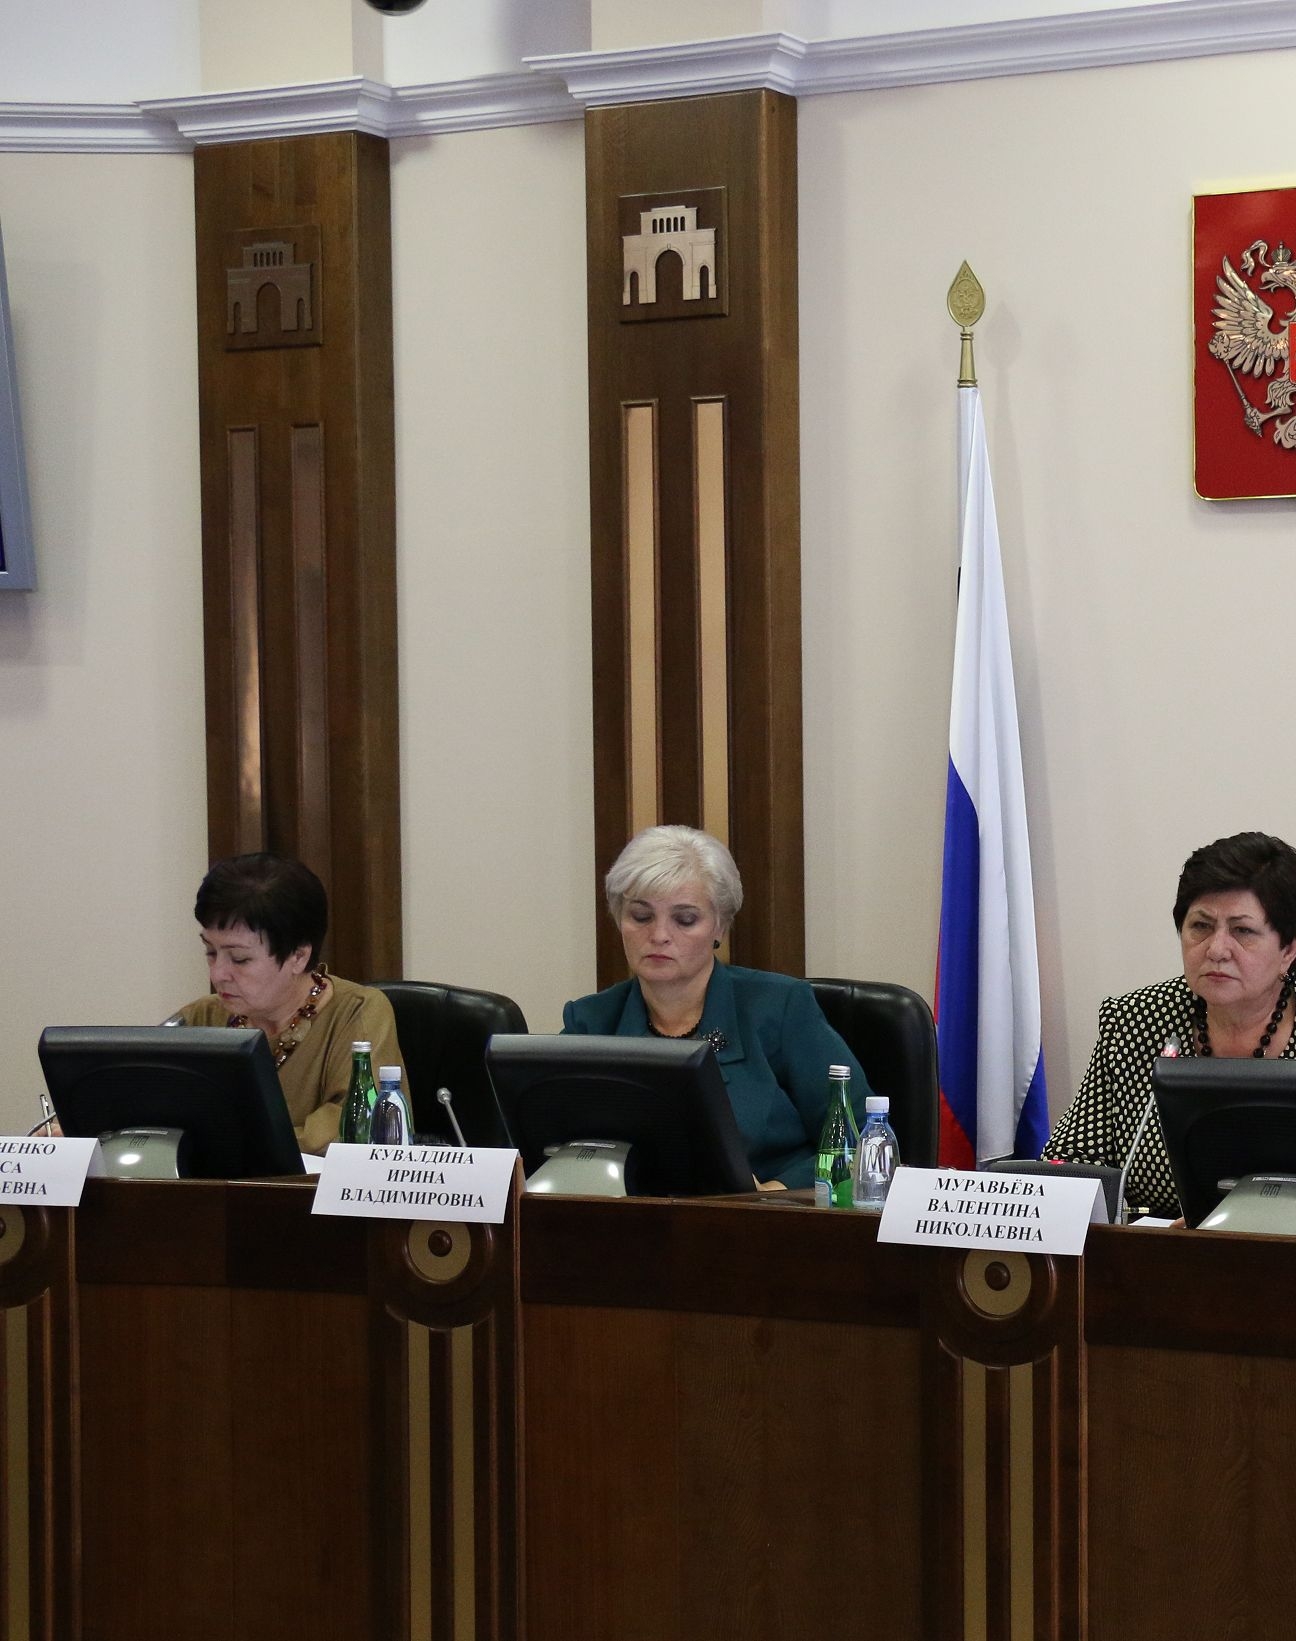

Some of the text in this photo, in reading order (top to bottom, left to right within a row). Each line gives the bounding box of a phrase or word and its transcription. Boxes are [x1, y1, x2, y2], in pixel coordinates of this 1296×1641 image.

[369, 1148, 474, 1165] КУВАЛДИНА
[386, 1168, 446, 1185] ИРИНА
[0, 1180, 47, 1196] ЕВНА
[934, 1177, 1045, 1197] МУРАВЬЁВА
[340, 1187, 485, 1208] ВЛАДИМИРОВНА
[927, 1198, 1041, 1219] ВАЛЕНТИНА
[915, 1219, 1044, 1242] НИКОЛАЕВНА
